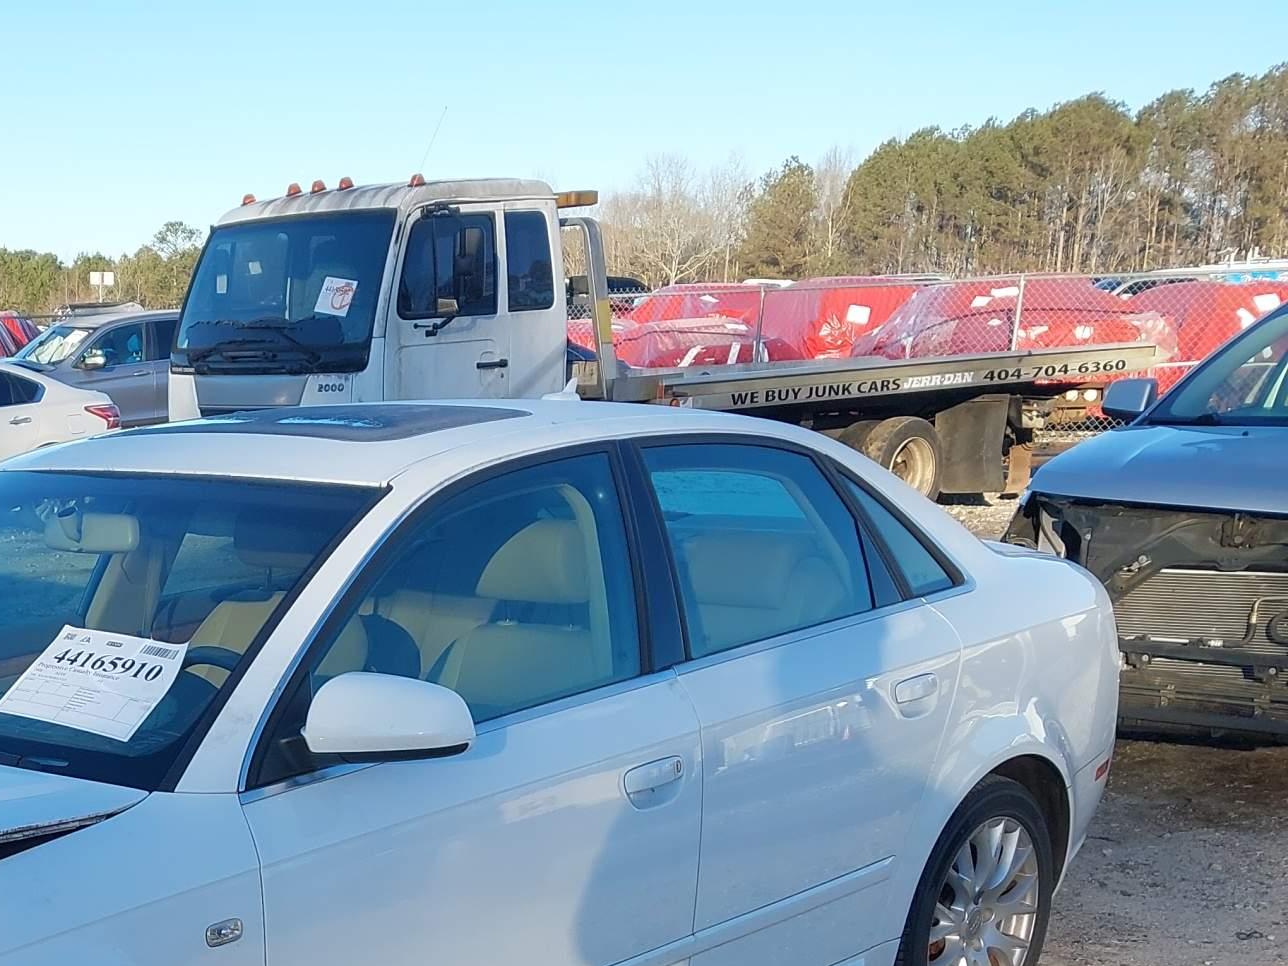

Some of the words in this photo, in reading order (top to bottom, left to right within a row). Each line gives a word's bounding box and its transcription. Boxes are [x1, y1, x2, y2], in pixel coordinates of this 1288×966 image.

[317, 383, 345, 393] 2000
[731, 391, 759, 406] WE
[765, 387, 802, 403] BUY
[806, 383, 853, 400] JUNK
[857, 378, 901, 394] CARS
[983, 359, 1127, 382] 404-704-6360
[54, 648, 164, 682] 44165910
